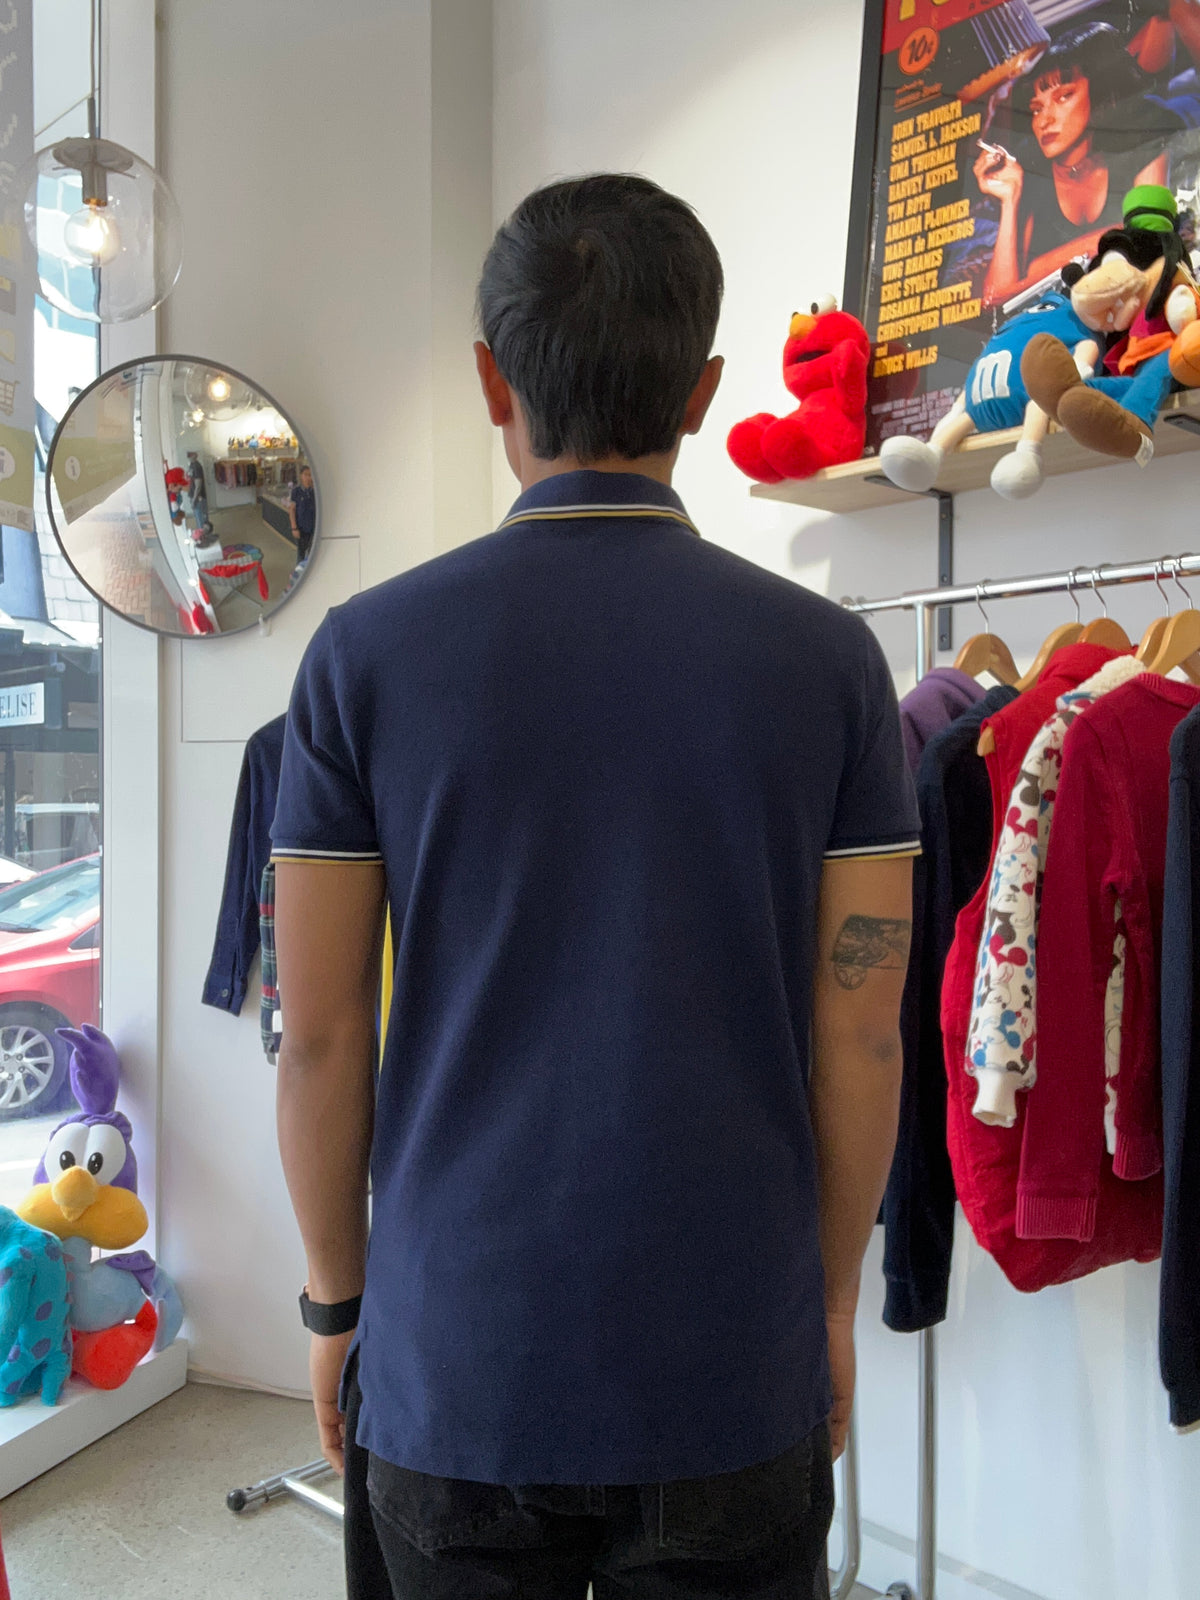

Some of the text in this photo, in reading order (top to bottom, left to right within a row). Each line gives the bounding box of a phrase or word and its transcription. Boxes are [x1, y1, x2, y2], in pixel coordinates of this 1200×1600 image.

[891, 133, 928, 162] SAMUEL
[940, 112, 981, 145] JACKSON
[892, 99, 962, 143] JOHN TRAVOLTA
[888, 163, 958, 203] HARVEY KEITEL
[889, 142, 957, 183] UMA THURMAN
[884, 199, 970, 243] AMANDA PLUMMER
[887, 191, 932, 223] TIM ROTH
[884, 238, 913, 264] MARIA
[926, 217, 976, 249] MEDEIROS
[904, 247, 943, 276] RHAMES
[878, 280, 973, 323] ROSANNA ARQUETTE
[880, 280, 902, 304] ERIC
[876, 297, 981, 343] CHRISTOPHER WALKEN
[873, 345, 938, 378] BRUCE WILLIS
[971, 350, 1012, 405] m
